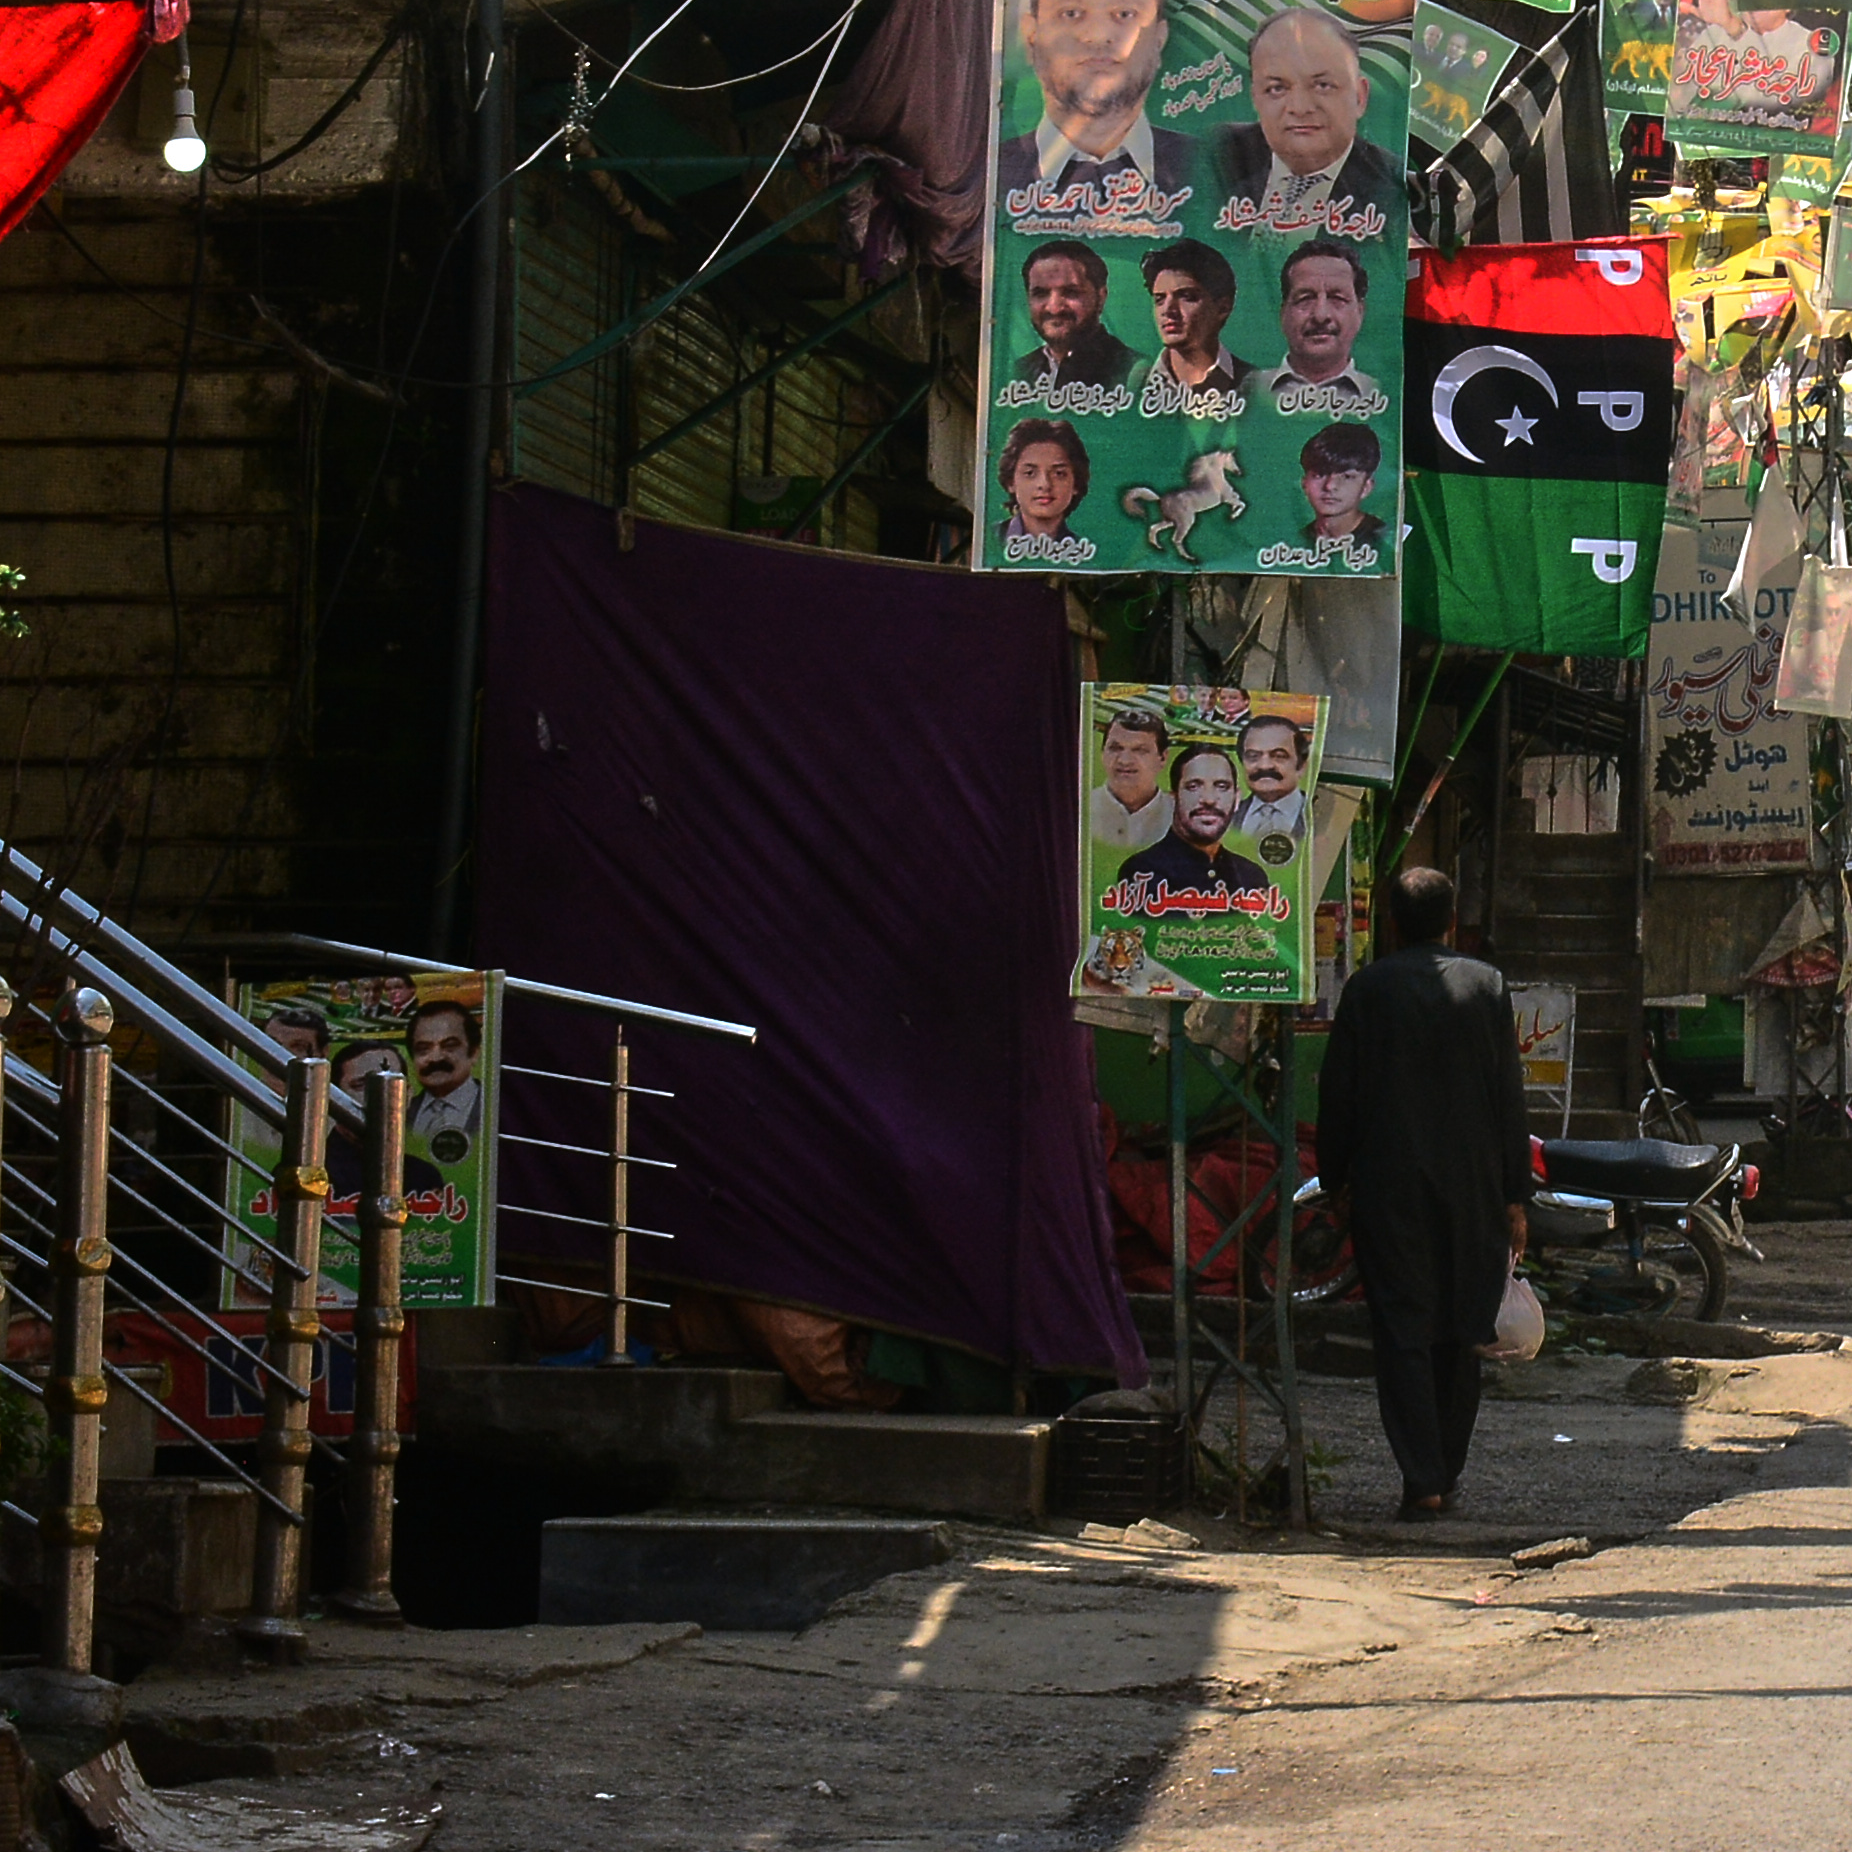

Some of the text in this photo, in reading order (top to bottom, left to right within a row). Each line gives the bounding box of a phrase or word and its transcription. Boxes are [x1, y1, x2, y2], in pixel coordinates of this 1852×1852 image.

[1675, 43, 1819, 105] راجہ مبشر اعجاز
[1005, 168, 1193, 221] سردار عتیق احمد خان
[1212, 189, 1284, 231] شمشاد
[1270, 194, 1355, 232] کاشف
[1337, 202, 1387, 241] راجہ
[995, 371, 1134, 418] راجہ ذیشان شمشاد
[1212, 389, 1247, 421] راجہ
[1276, 383, 1319, 415] خان
[1353, 389, 1389, 420] راجہ
[1571, 249, 1644, 584] P P P
[1069, 538, 1097, 566] راجہ
[1256, 542, 1304, 568] عدنان
[1697, 570, 1716, 584] To
[1652, 587, 1796, 623] DHIROT
[1101, 870, 1290, 921] راجہ فیصل آزاد
